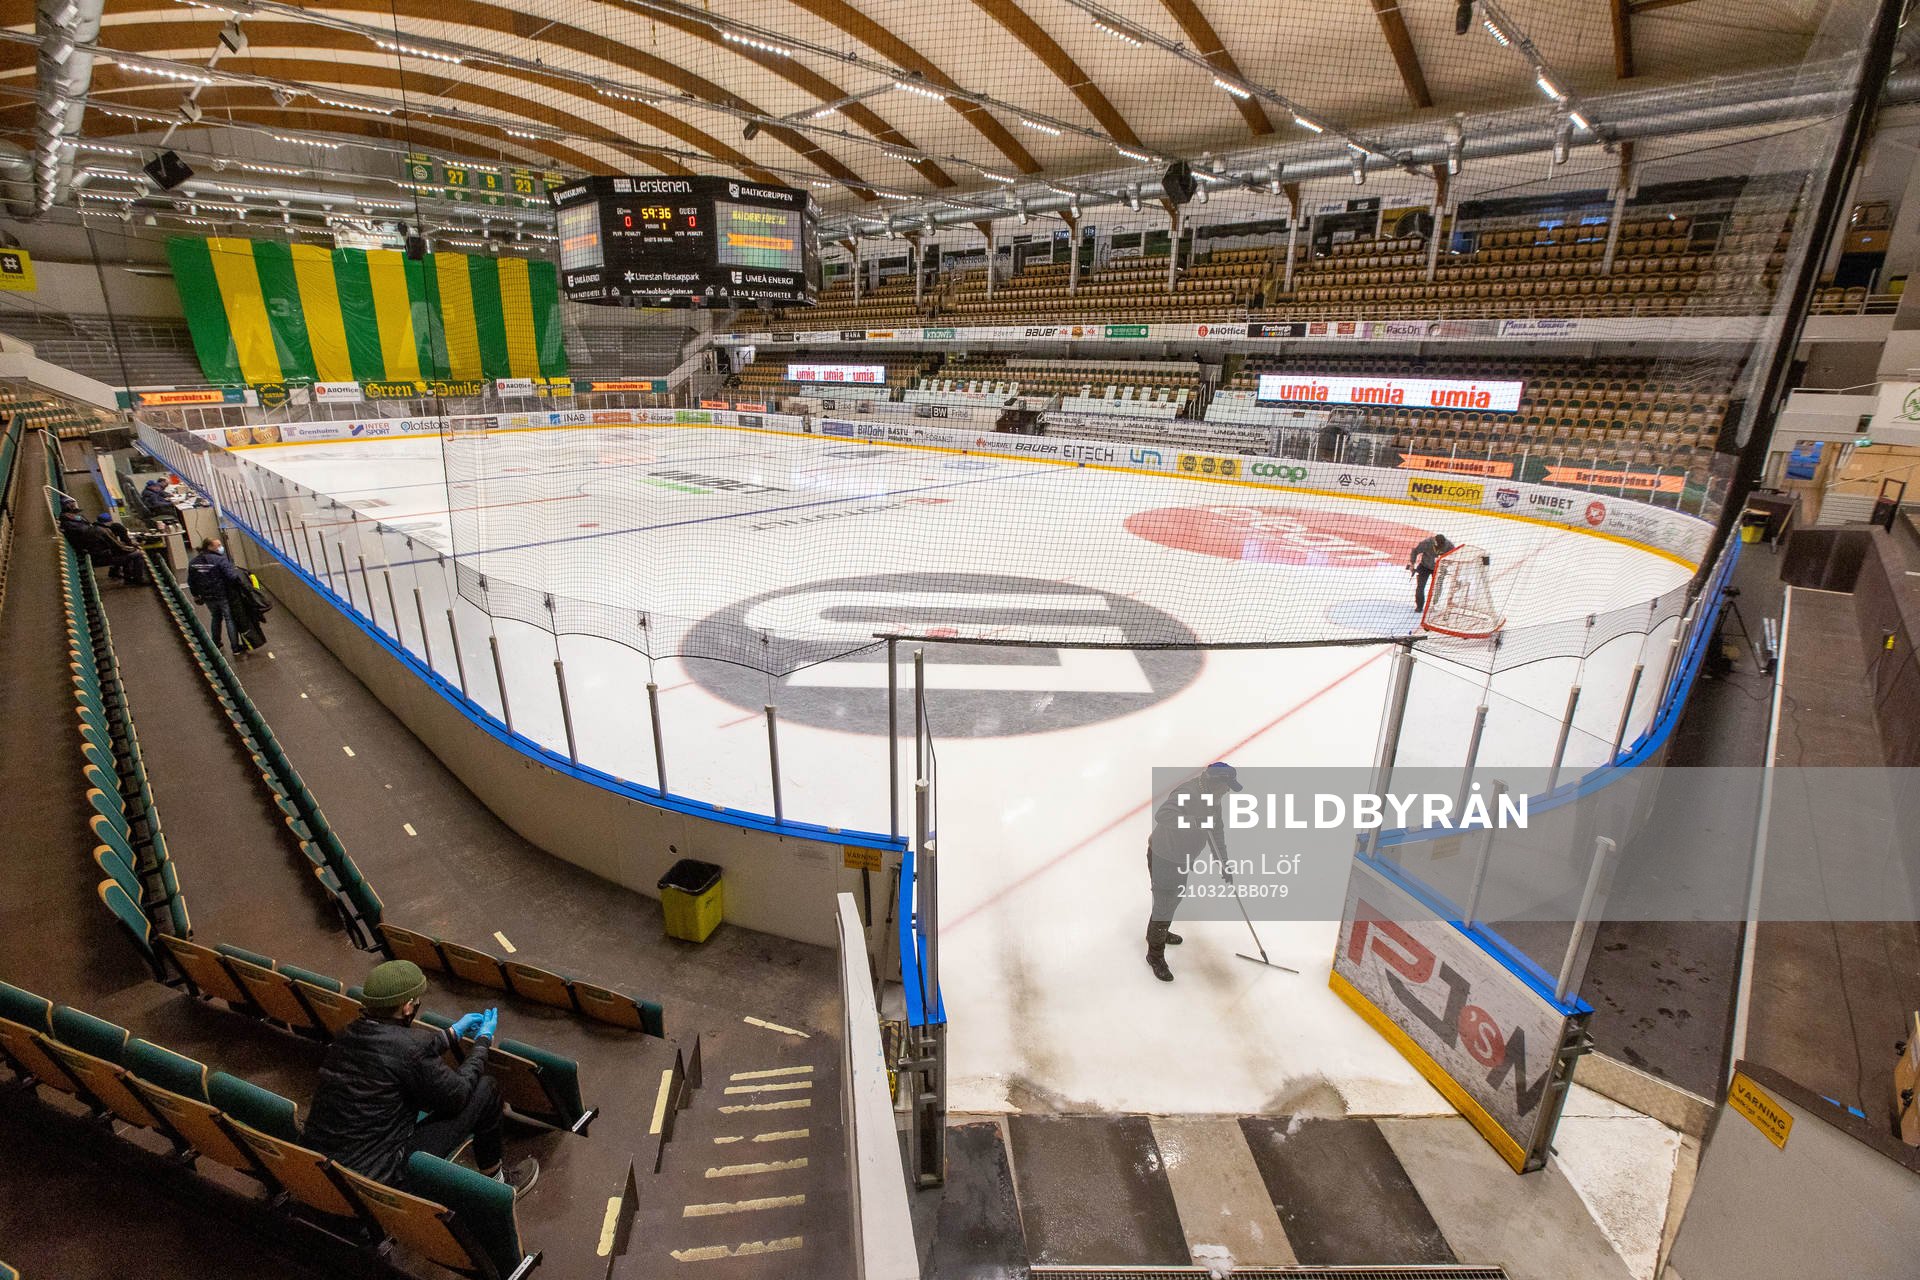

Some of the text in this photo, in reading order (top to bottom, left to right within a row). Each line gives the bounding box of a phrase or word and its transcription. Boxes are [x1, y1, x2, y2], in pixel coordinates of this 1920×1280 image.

[447, 170, 463, 184] 27
[486, 175, 495, 188] 9
[515, 179, 531, 193] 23
[741, 187, 793, 202] BALTICGRUPPEN
[642, 208, 671, 219] 59:36
[625, 216, 632, 227] 0
[688, 216, 696, 227] 0
[745, 274, 794, 285] UMEÅ ENERGI
[751, 290, 791, 299] FASTIGHETER
[1209, 326, 1246, 336] AllOffice
[796, 367, 875, 383] umia umia umia
[366, 382, 482, 398] Green Devils
[1280, 381, 1492, 408] umia umia umia
[564, 414, 586, 422] INAB
[934, 407, 947, 418] BW
[1015, 442, 1058, 454] BAUER
[1251, 462, 1308, 483] coop
[1354, 478, 1376, 488] SCA
[1529, 493, 1574, 511] UNIBET
[1738, 1084, 1786, 1130] VARNING
